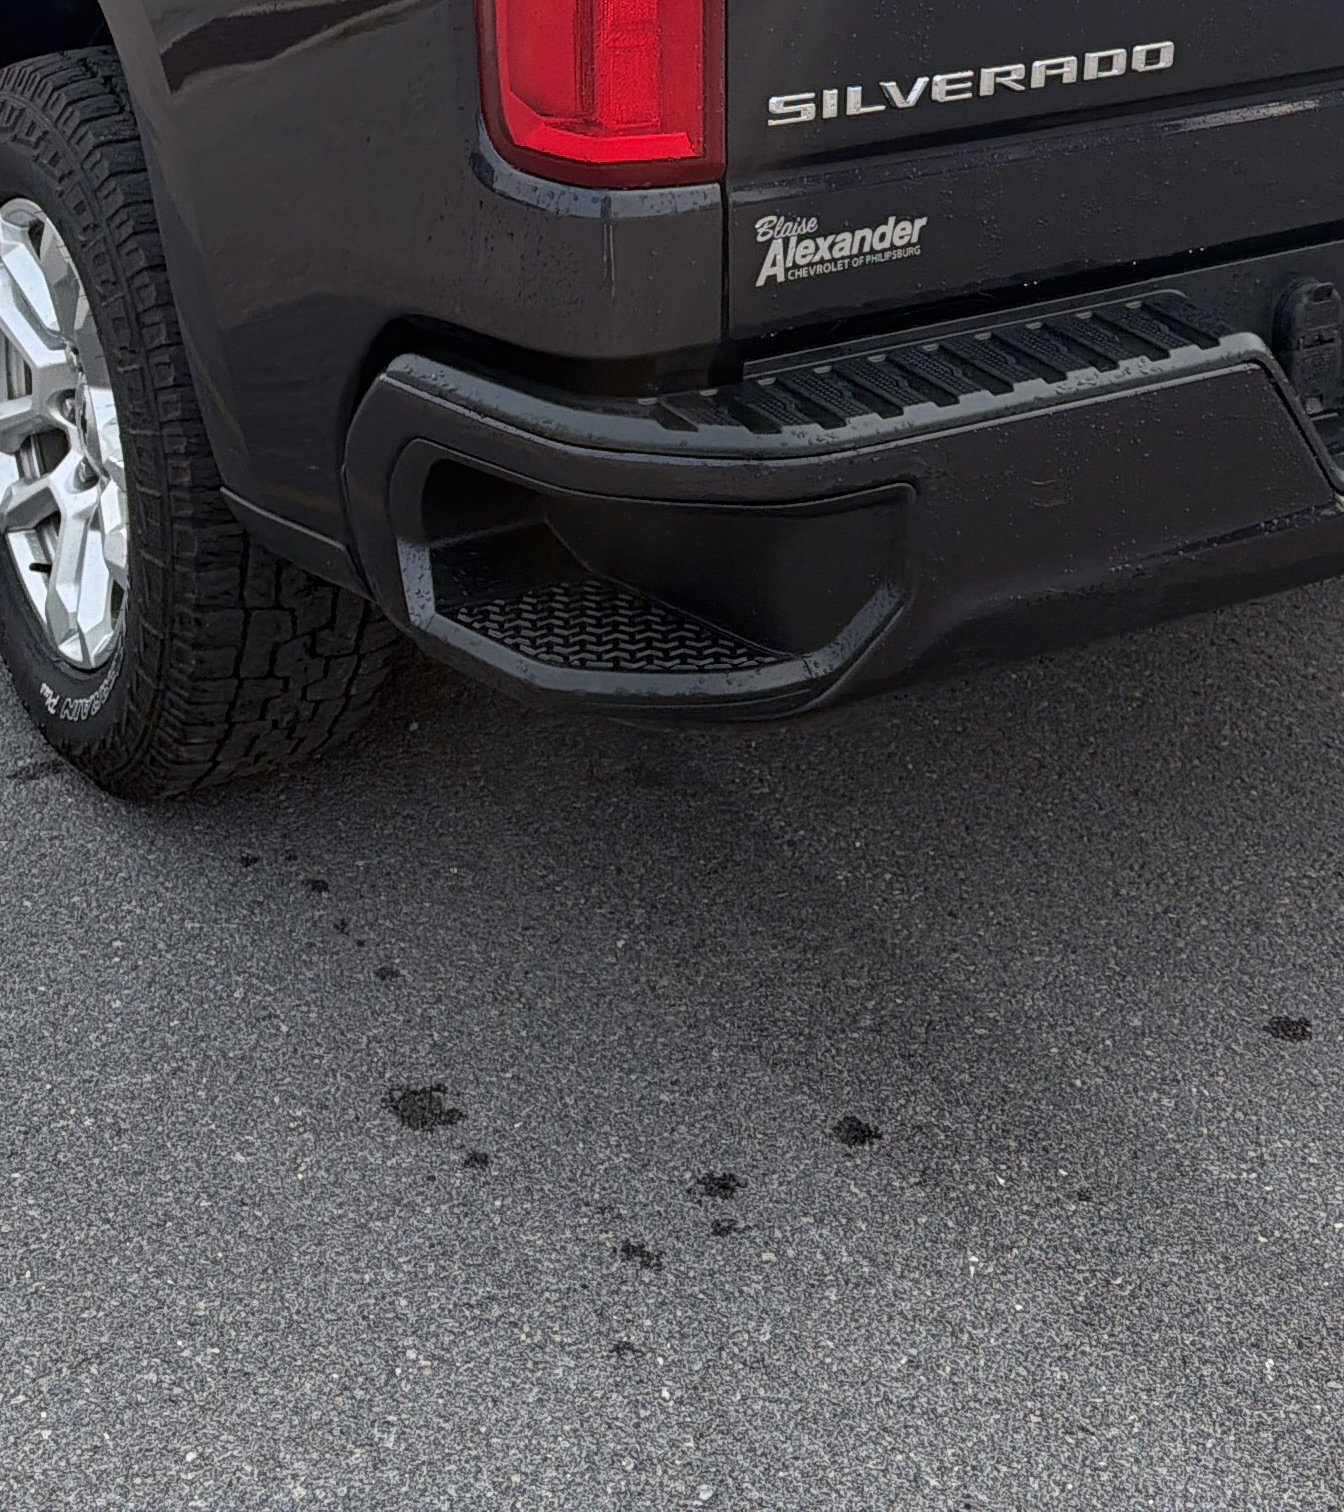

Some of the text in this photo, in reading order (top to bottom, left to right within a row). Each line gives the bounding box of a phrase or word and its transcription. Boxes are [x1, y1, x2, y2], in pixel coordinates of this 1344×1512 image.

[767, 40, 1175, 127] SILVERADO
[755, 215, 818, 242] Blaise
[755, 216, 928, 287] Alexander
[788, 245, 921, 281] CHEVROLET OF PHILIPSBURG
